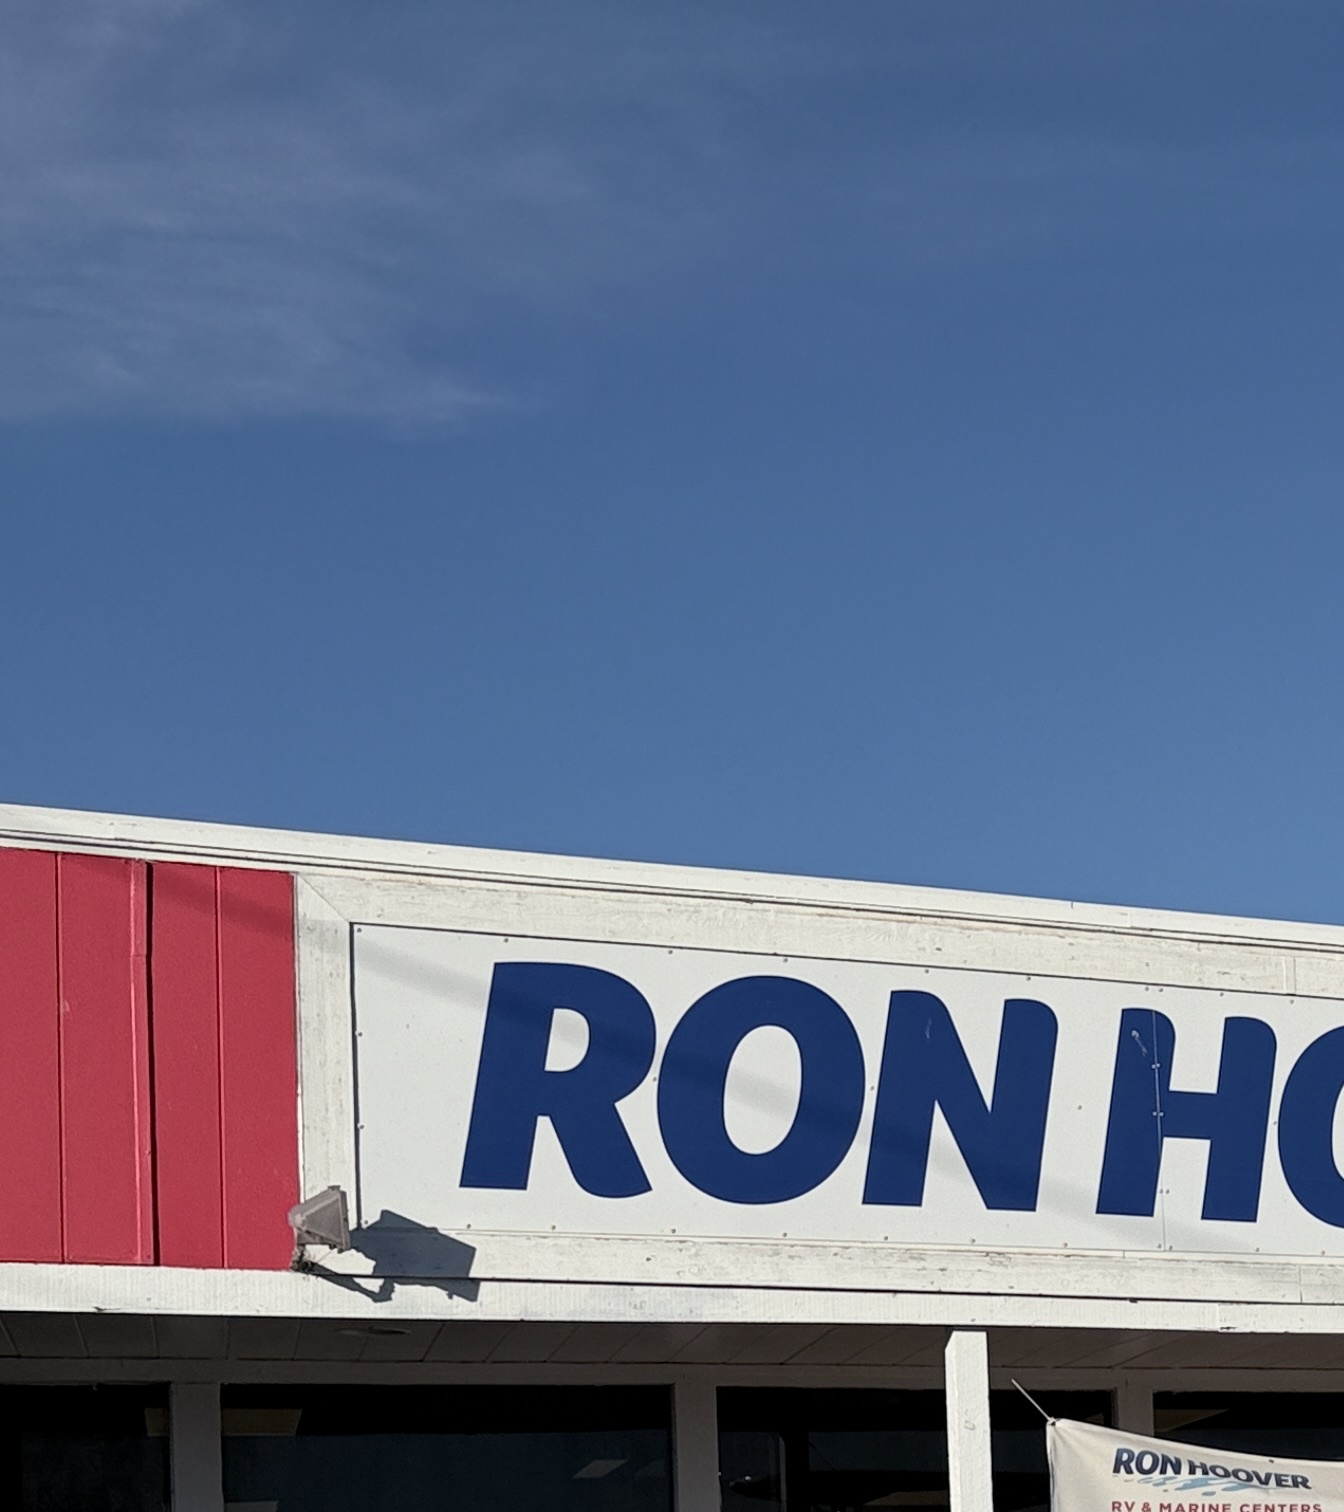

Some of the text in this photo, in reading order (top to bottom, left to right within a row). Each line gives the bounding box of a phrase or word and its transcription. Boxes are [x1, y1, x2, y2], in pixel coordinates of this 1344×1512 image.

[459, 961, 1058, 1212] RON
[1112, 1447, 1312, 1490] RON HOOVER
[1112, 1501, 1135, 1512] RV
[1142, 1502, 1152, 1512] &
